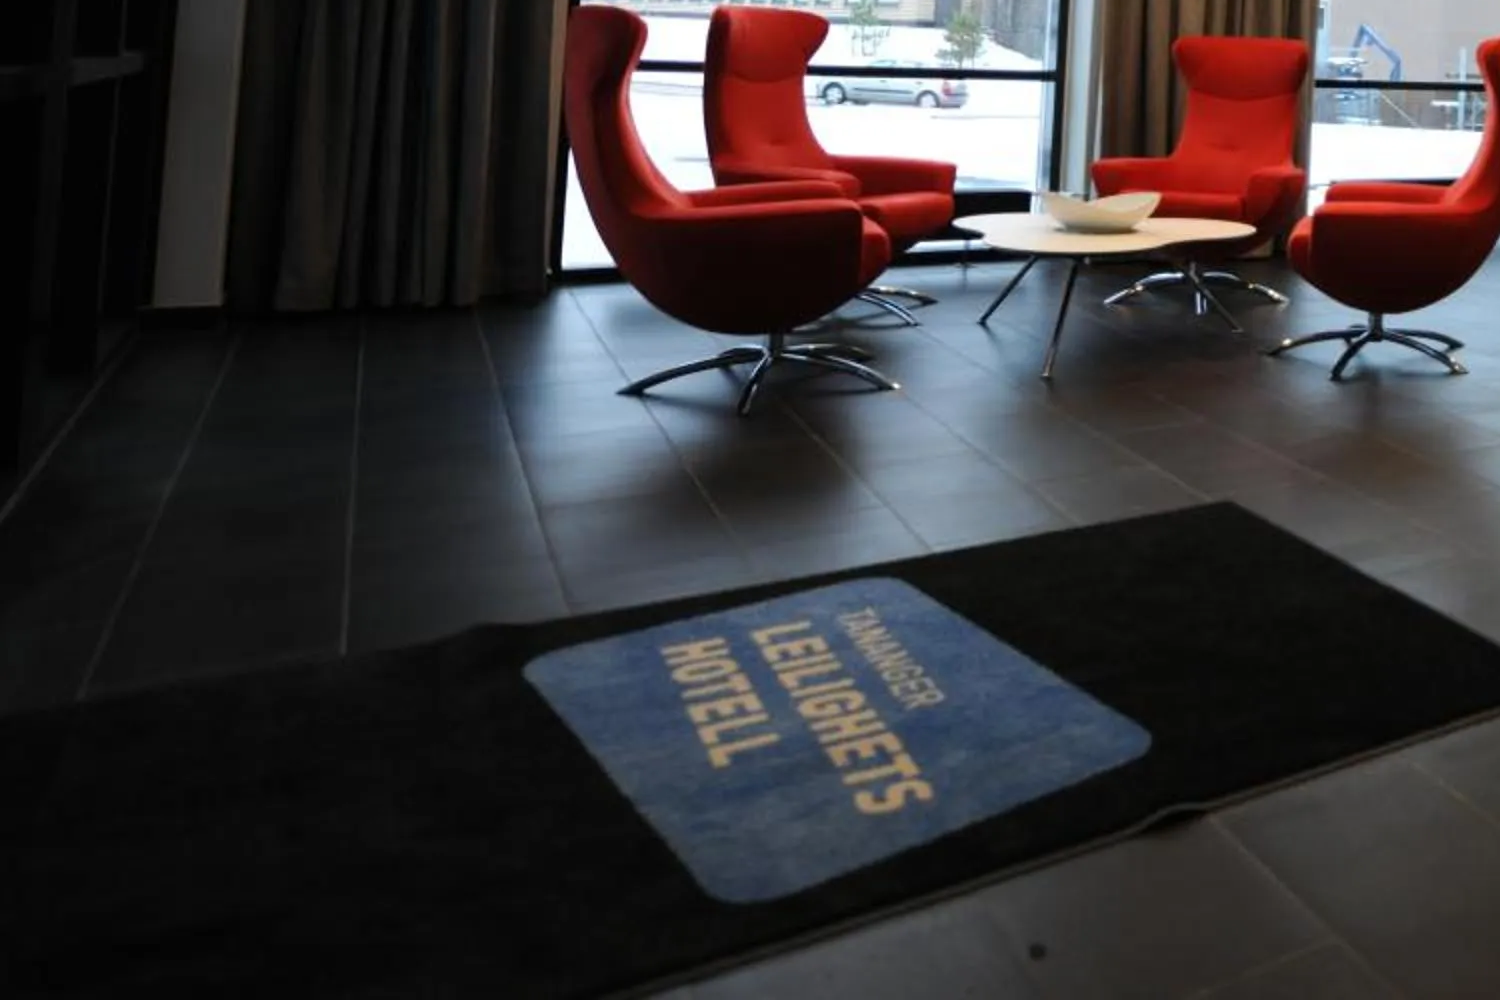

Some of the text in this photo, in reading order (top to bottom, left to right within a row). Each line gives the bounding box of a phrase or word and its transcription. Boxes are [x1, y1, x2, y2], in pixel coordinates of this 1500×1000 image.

[661, 637, 782, 769] HOTELL
[752, 620, 934, 814] LEILIGHETS
[837, 606, 945, 710] TANANGER
